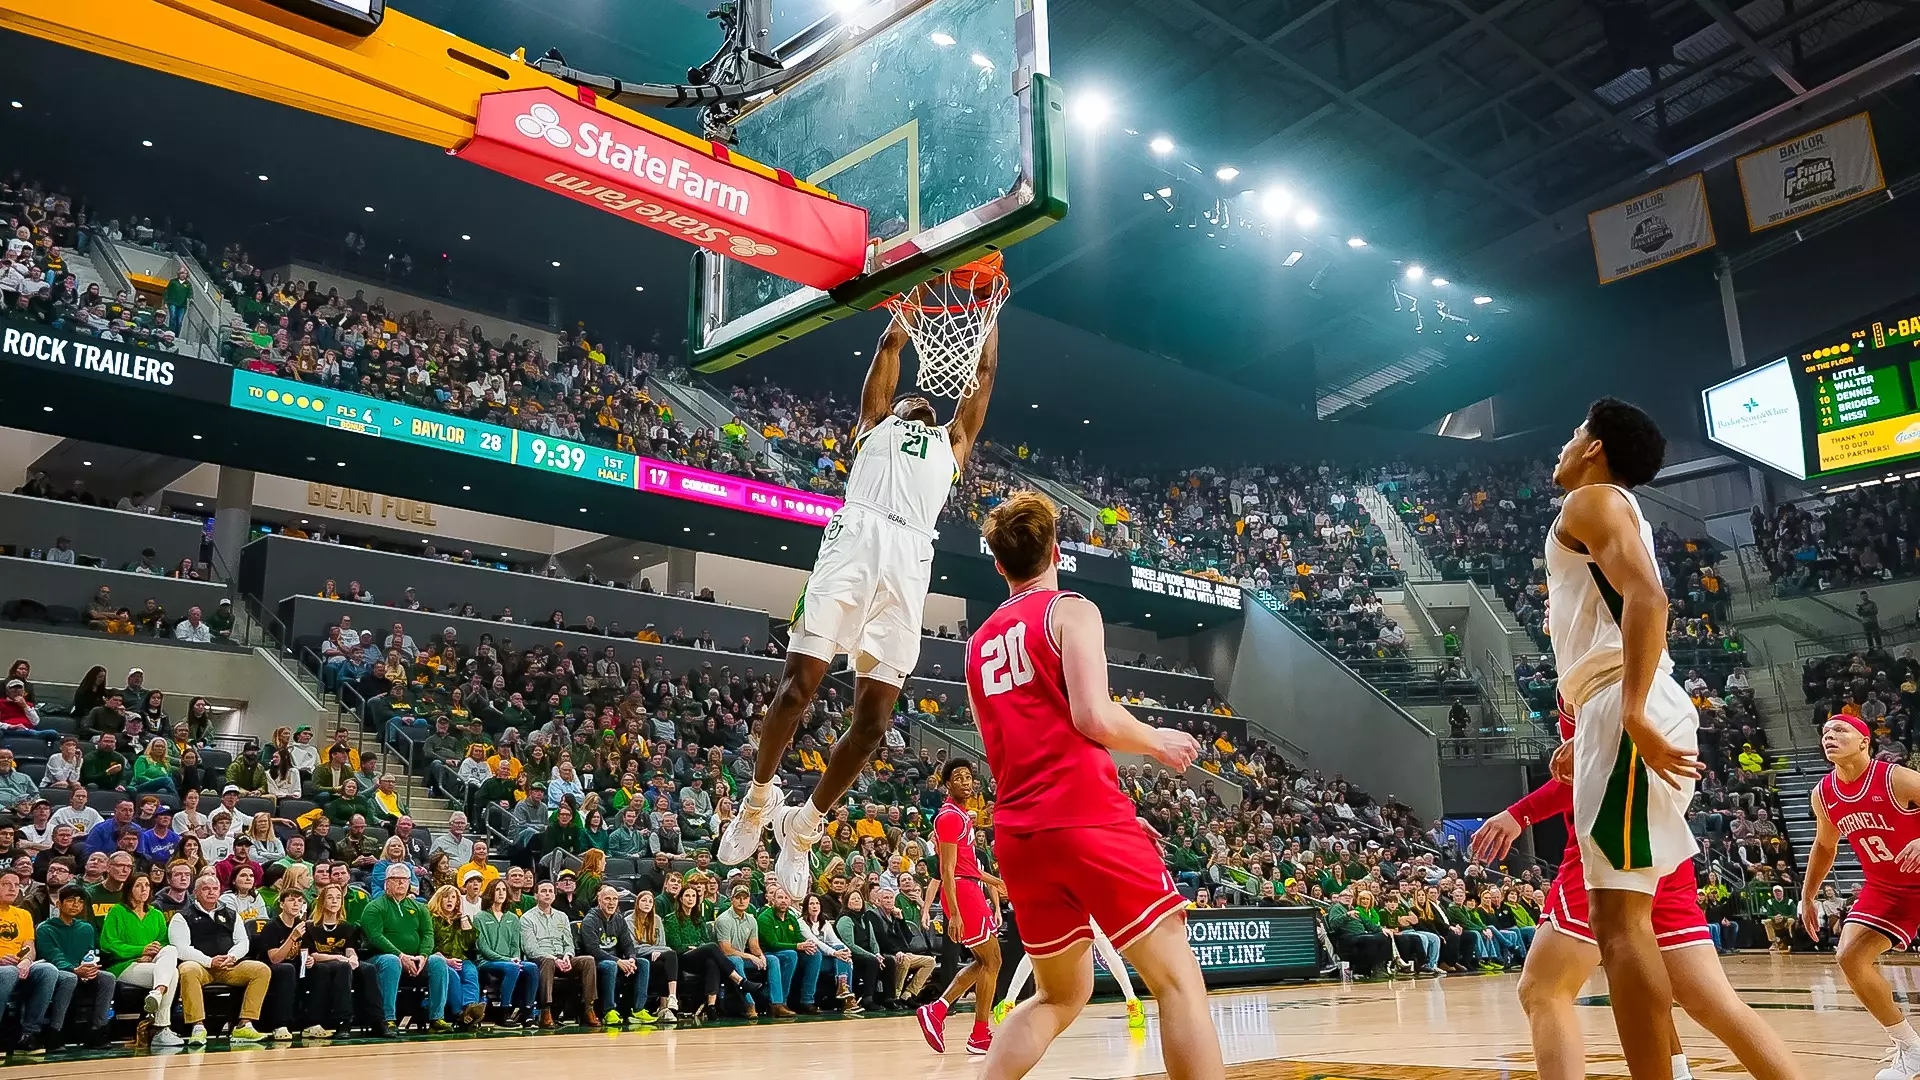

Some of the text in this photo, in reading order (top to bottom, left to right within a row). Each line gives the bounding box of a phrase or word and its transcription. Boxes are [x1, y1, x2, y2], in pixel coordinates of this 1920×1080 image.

[1779, 133, 1825, 160] BAYLOR
[1796, 160, 1832, 179] FINAL
[1786, 170, 1834, 201] FOUR
[1625, 192, 1665, 217] BAYLOR
[1784, 200, 1820, 217] NATIONAL
[1820, 184, 1865, 206] CHAMPIONS
[1630, 253, 1660, 272] NATIONAL
[1660, 242, 1698, 260] CHAMPIONS
[1851, 330, 1866, 339] FLS
[1857, 340, 1865, 348] 4
[3, 327, 175, 386] ROCK TRAILERS
[1801, 353, 1812, 362] TO
[1805, 356, 1854, 374] ON THE FLOOR
[1817, 365, 1866, 384] 1 LITTLE
[1834, 375, 1875, 391] WALTER
[248, 386, 264, 399] TO
[1819, 386, 1873, 405] 10 DENNIS
[336, 405, 373, 424] FLS 4
[1820, 395, 1881, 416] 11 BRIDGES
[339, 420, 366, 433] BONUS
[1822, 410, 1867, 427] 21 MISSI
[411, 418, 502, 452] BAYLOR 28
[1830, 430, 1875, 445] THANK YOU
[1852, 440, 1868, 449] OUR
[531, 438, 586, 472] 9:39
[900, 432, 929, 460] 21
[1822, 444, 1890, 463] WACO PARTNERS!
[603, 455, 624, 470] 1ST
[597, 468, 628, 483] HALF
[649, 468, 668, 487] 17
[681, 477, 728, 498] CORNELL
[307, 482, 437, 527] BEAR FUEL
[751, 492, 778, 508] FLS 6
[784, 499, 795, 510] TO
[887, 511, 907, 526] BEARS
[1196, 591, 1216, 604] WITH
[980, 621, 1036, 698] 20
[1836, 811, 1896, 838] CORNELL
[1858, 835, 1895, 864] 13
[1228, 943, 1267, 965] LINE
